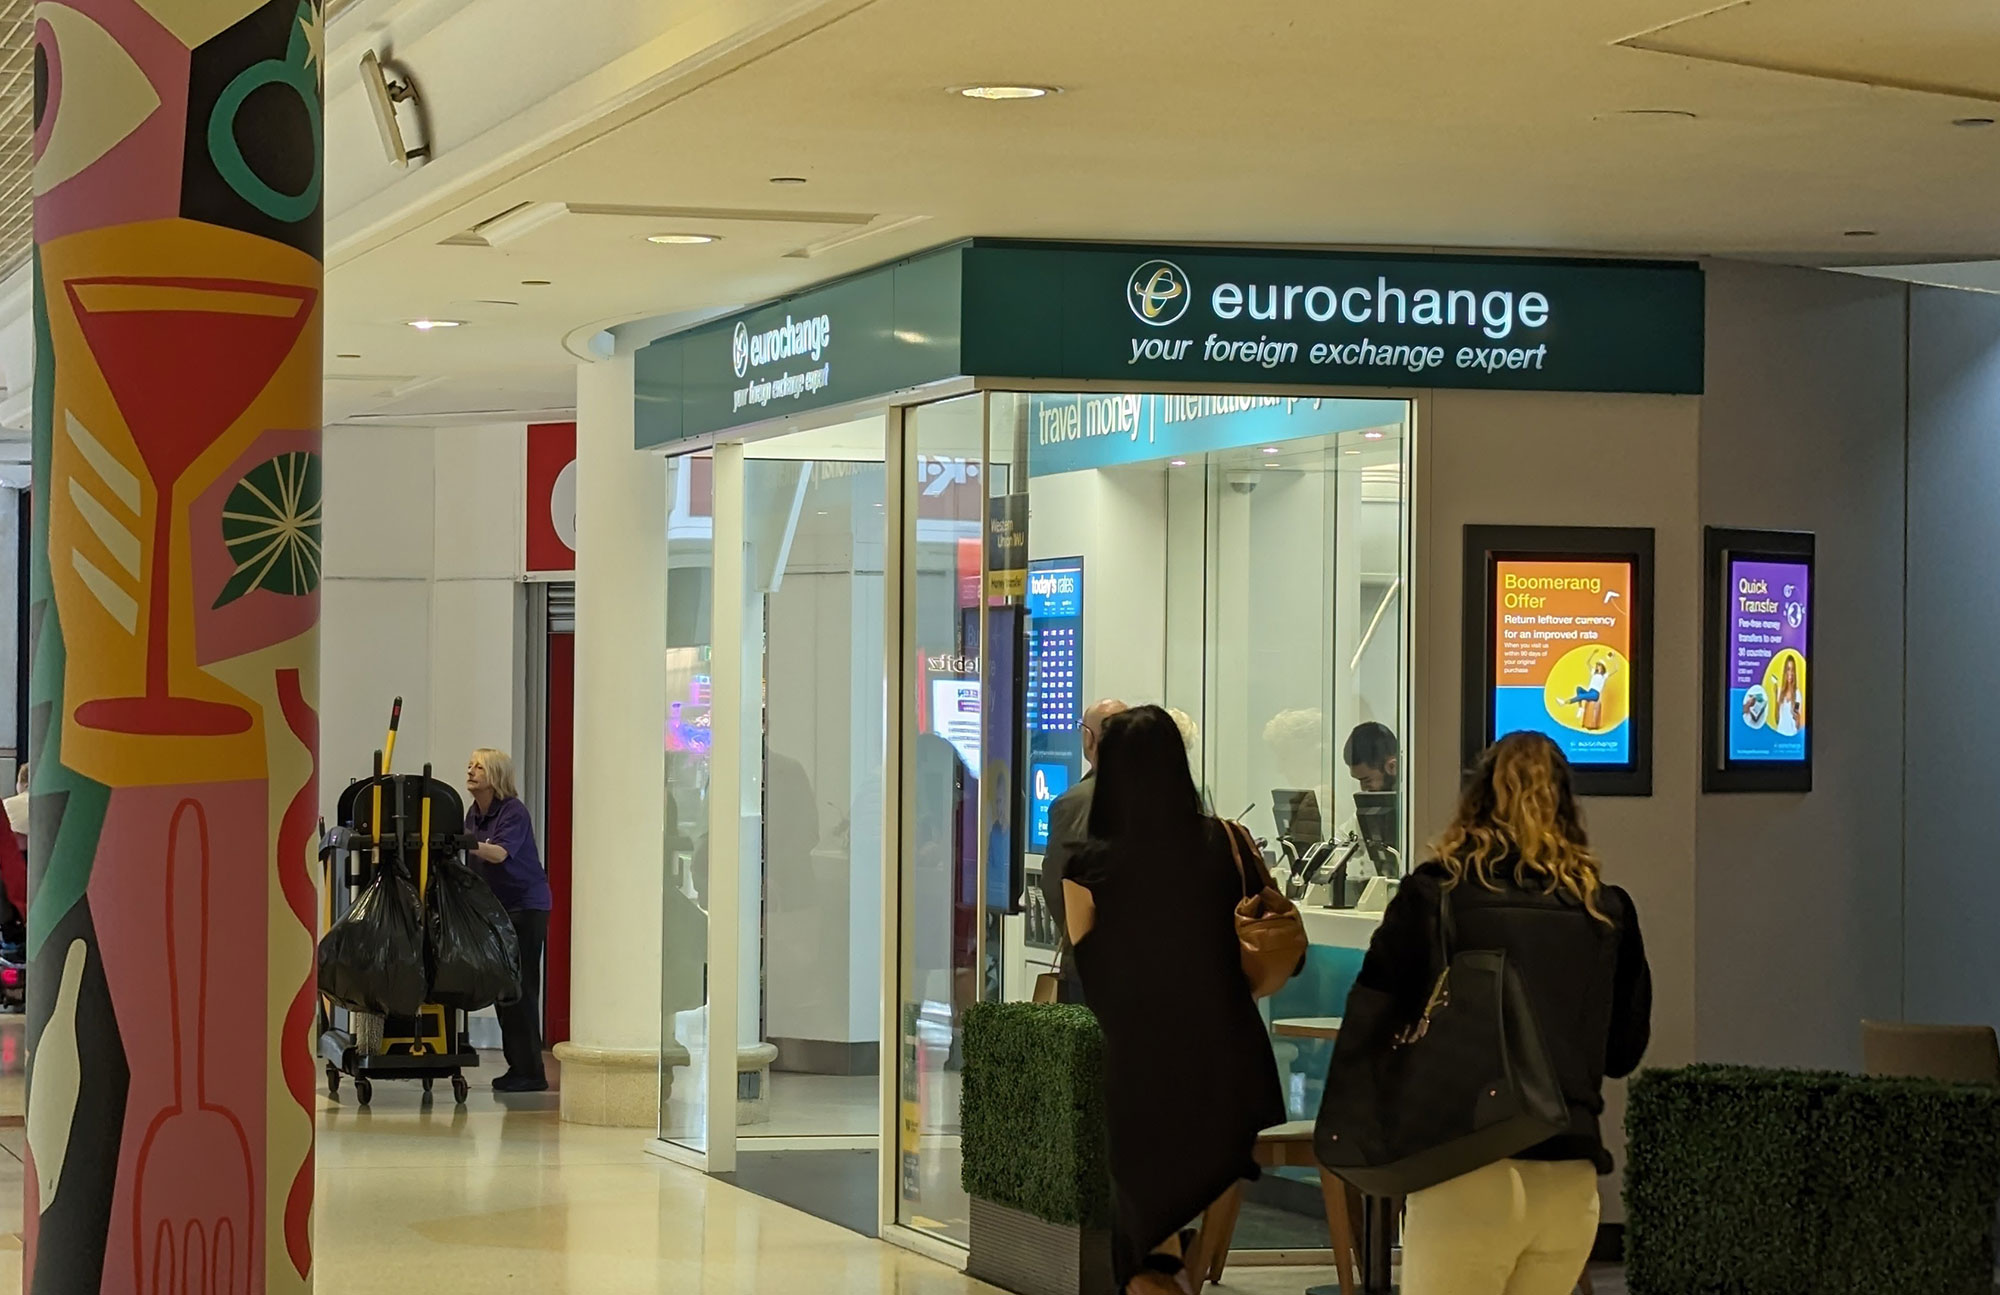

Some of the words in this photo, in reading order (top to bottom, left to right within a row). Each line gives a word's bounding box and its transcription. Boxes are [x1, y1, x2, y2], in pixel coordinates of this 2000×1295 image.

[1212, 276, 1549, 339] eurochange
[750, 314, 830, 366] eurochange
[1127, 338, 1193, 365] your
[1203, 333, 1298, 368] foreign
[1309, 338, 1444, 373] exchange
[1456, 343, 1547, 374] expert
[1039, 393, 1081, 446] travel
[1086, 394, 1142, 441] money
[1031, 574, 1057, 599] today's
[1504, 574, 1601, 593] Boomerang
[1739, 578, 1768, 594] Quick
[1504, 593, 1547, 609] Offer
[1738, 597, 1779, 613] Transfer
[1504, 614, 1536, 625] Return
[1537, 614, 1573, 625] leftover
[1575, 616, 1616, 628] currency
[1503, 629, 1518, 639] for
[1519, 630, 1532, 639] an
[1533, 629, 1578, 641] improved
[1579, 630, 1599, 640] rate
